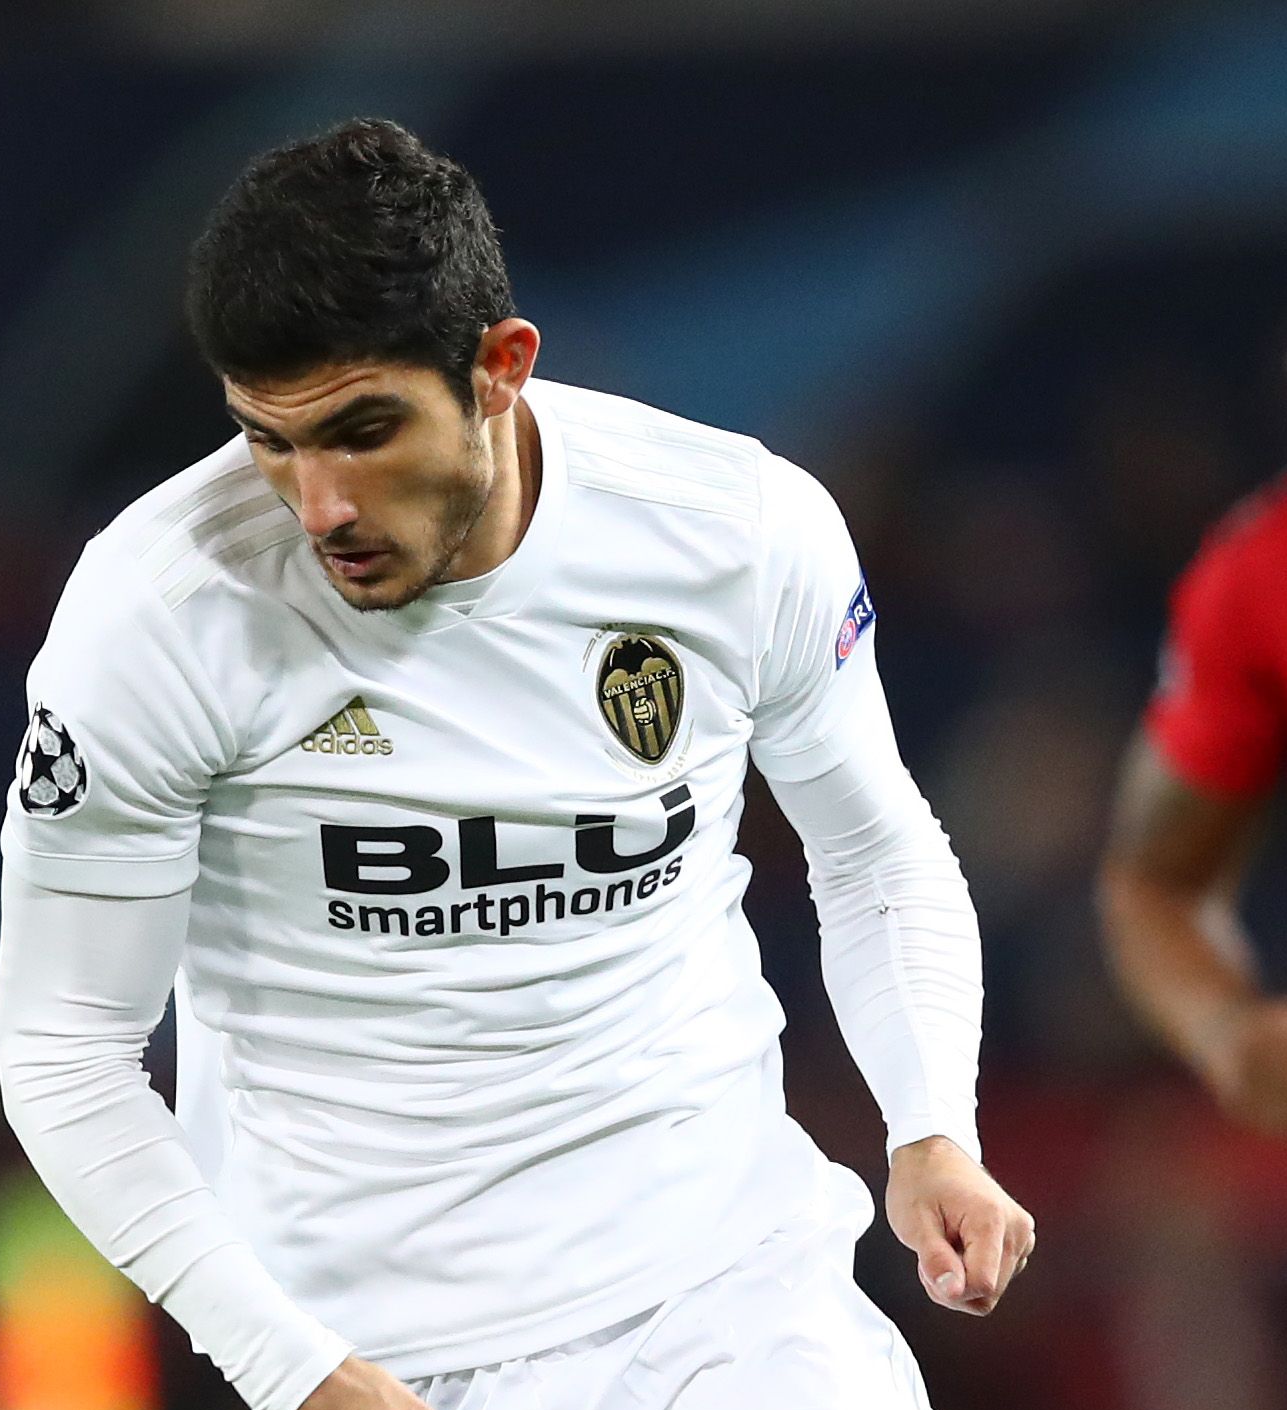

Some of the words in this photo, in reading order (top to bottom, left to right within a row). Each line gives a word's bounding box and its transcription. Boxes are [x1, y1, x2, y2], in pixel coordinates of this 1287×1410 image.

[604, 673, 655, 699] VALENCIA
[299, 731, 394, 756] adidas
[320, 784, 696, 896] BLU
[327, 855, 684, 937] smartphones
